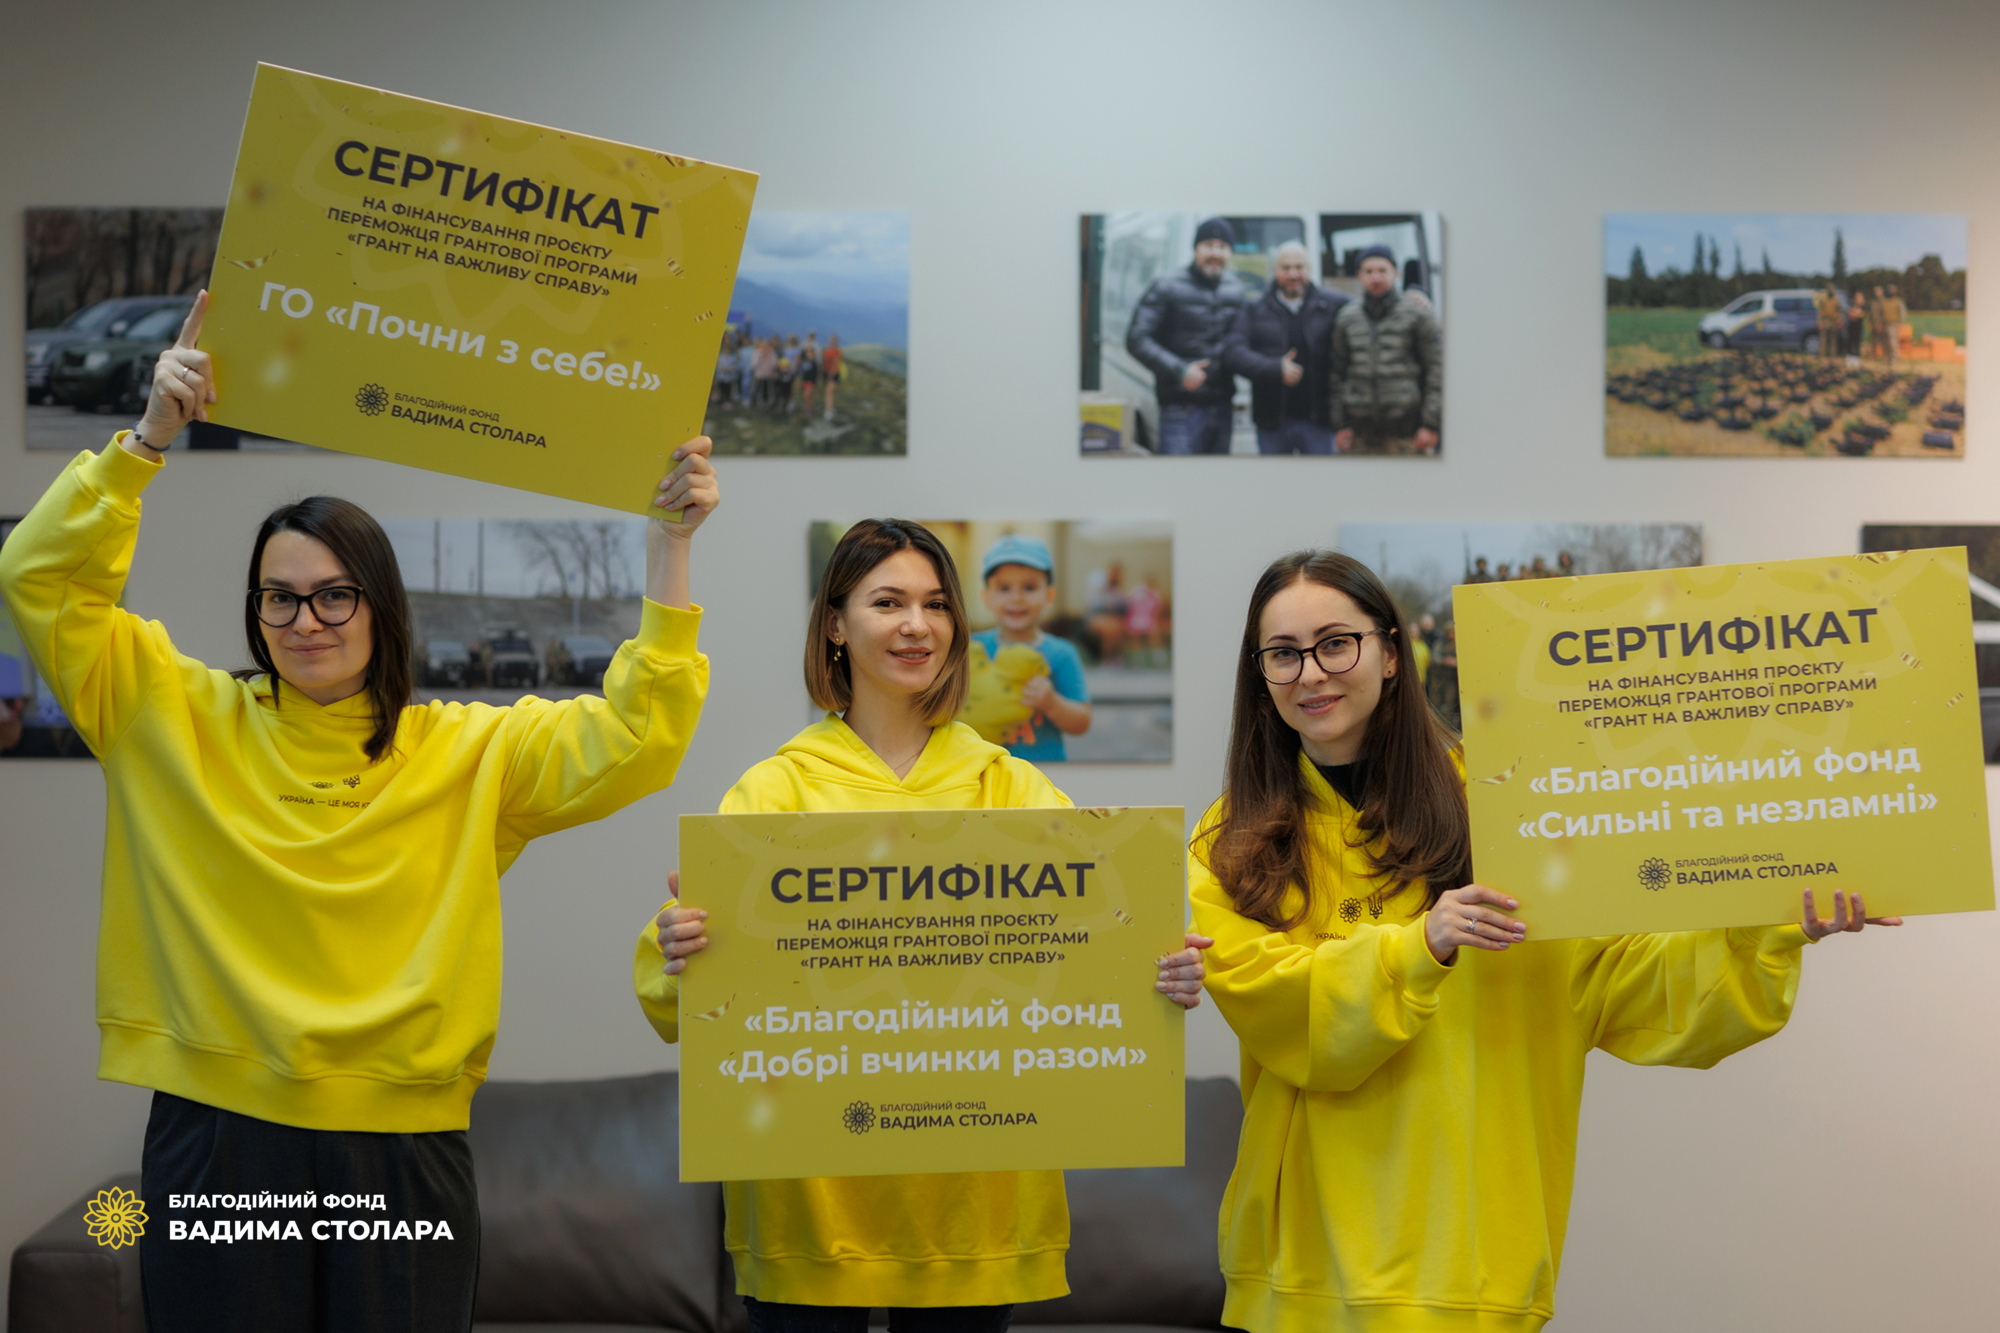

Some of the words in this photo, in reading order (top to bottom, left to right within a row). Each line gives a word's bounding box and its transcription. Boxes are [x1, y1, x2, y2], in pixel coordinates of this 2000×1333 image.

[335, 141, 659, 238] СЕРТИФІКАТ
[363, 196, 386, 212] НА
[392, 203, 530, 242] ФІНАНСУВАННЯ
[535, 234, 612, 259] ПРОЄКТУ
[328, 208, 439, 242] ПЕРЕМОЖЦЯ
[444, 233, 541, 264] ГРАНТОВОЇ
[544, 255, 637, 285] ПРОГРАМИ
[348, 233, 411, 255] «ГРАНТ
[415, 246, 438, 262] НА
[445, 253, 530, 280] ВАЖЛИВУ
[535, 273, 609, 296] СПРАВУ»
[260, 282, 313, 318] ГО
[326, 301, 485, 357] «Почни
[496, 340, 519, 363] з
[531, 348, 661, 391] себе!»
[395, 393, 467, 414] БЛАГОДІЙНИЙ
[469, 409, 499, 422] ФОНД
[391, 405, 464, 431] ВАДИМА
[470, 422, 546, 448] СТОЛАРА
[1549, 608, 1877, 666] СЕРТИФІКАТ
[1589, 679, 1613, 691] НА
[1618, 668, 1758, 689] ФІНАНСУВАННЯ
[1765, 662, 1843, 678] ПРОЄКТУ
[1559, 693, 1671, 712] ПЕРЕМОЖЦЯ
[1677, 683, 1774, 703] ГРАНТОВОЇ
[1780, 678, 1876, 696] ПРОГРАМИ
[1584, 714, 1647, 728] «ГРАНТ
[1653, 712, 1677, 724] НА
[1683, 705, 1770, 722] ВАЖЛИВУ
[1776, 699, 1853, 715] СПРАВУ»
[1529, 749, 1801, 794] «Благодійний
[1814, 747, 1921, 781] фонд
[279, 794, 315, 805] УКРАЇНА
[328, 799, 340, 807] ЦЕ
[1518, 801, 1671, 838] «Сильні
[1682, 806, 1723, 828] та
[1736, 783, 1938, 825] незламні»
[1676, 854, 1750, 868] БЛАГОДІЙНИЙ
[1752, 853, 1784, 862] ФОНД
[1677, 868, 1753, 885] ВАДИМА
[1757, 862, 1838, 878] СТОЛАРА
[771, 863, 1095, 903] СЕРТИФІКАТ
[808, 919, 831, 930] НА
[837, 916, 974, 930] ФІНАНСУВАННЯ
[981, 914, 1058, 926] ПРОЄКТУ
[777, 936, 887, 950] ПЕРЕМОЖЦЯ
[894, 931, 988, 947] ГРАНТОВОЇ
[995, 932, 1088, 945] ПРОГРАМИ
[801, 956, 863, 968] «ГРАНТ
[869, 955, 892, 967] НА
[898, 953, 983, 966] ВАЖЛИВУ
[989, 952, 1065, 964] СПРАВУ»
[745, 999, 1008, 1034] «Благодійний
[1021, 998, 1122, 1033] фонд
[719, 1045, 848, 1083] «Добрі
[862, 1050, 999, 1074] вчинки
[1014, 1047, 1147, 1076] разом»
[880, 1101, 953, 1112] БЛАГОДІЙНИЙ
[955, 1101, 986, 1110] ФОНД
[881, 1115, 954, 1130] ВАДИМА
[959, 1113, 1037, 1126] СТОЛАРА
